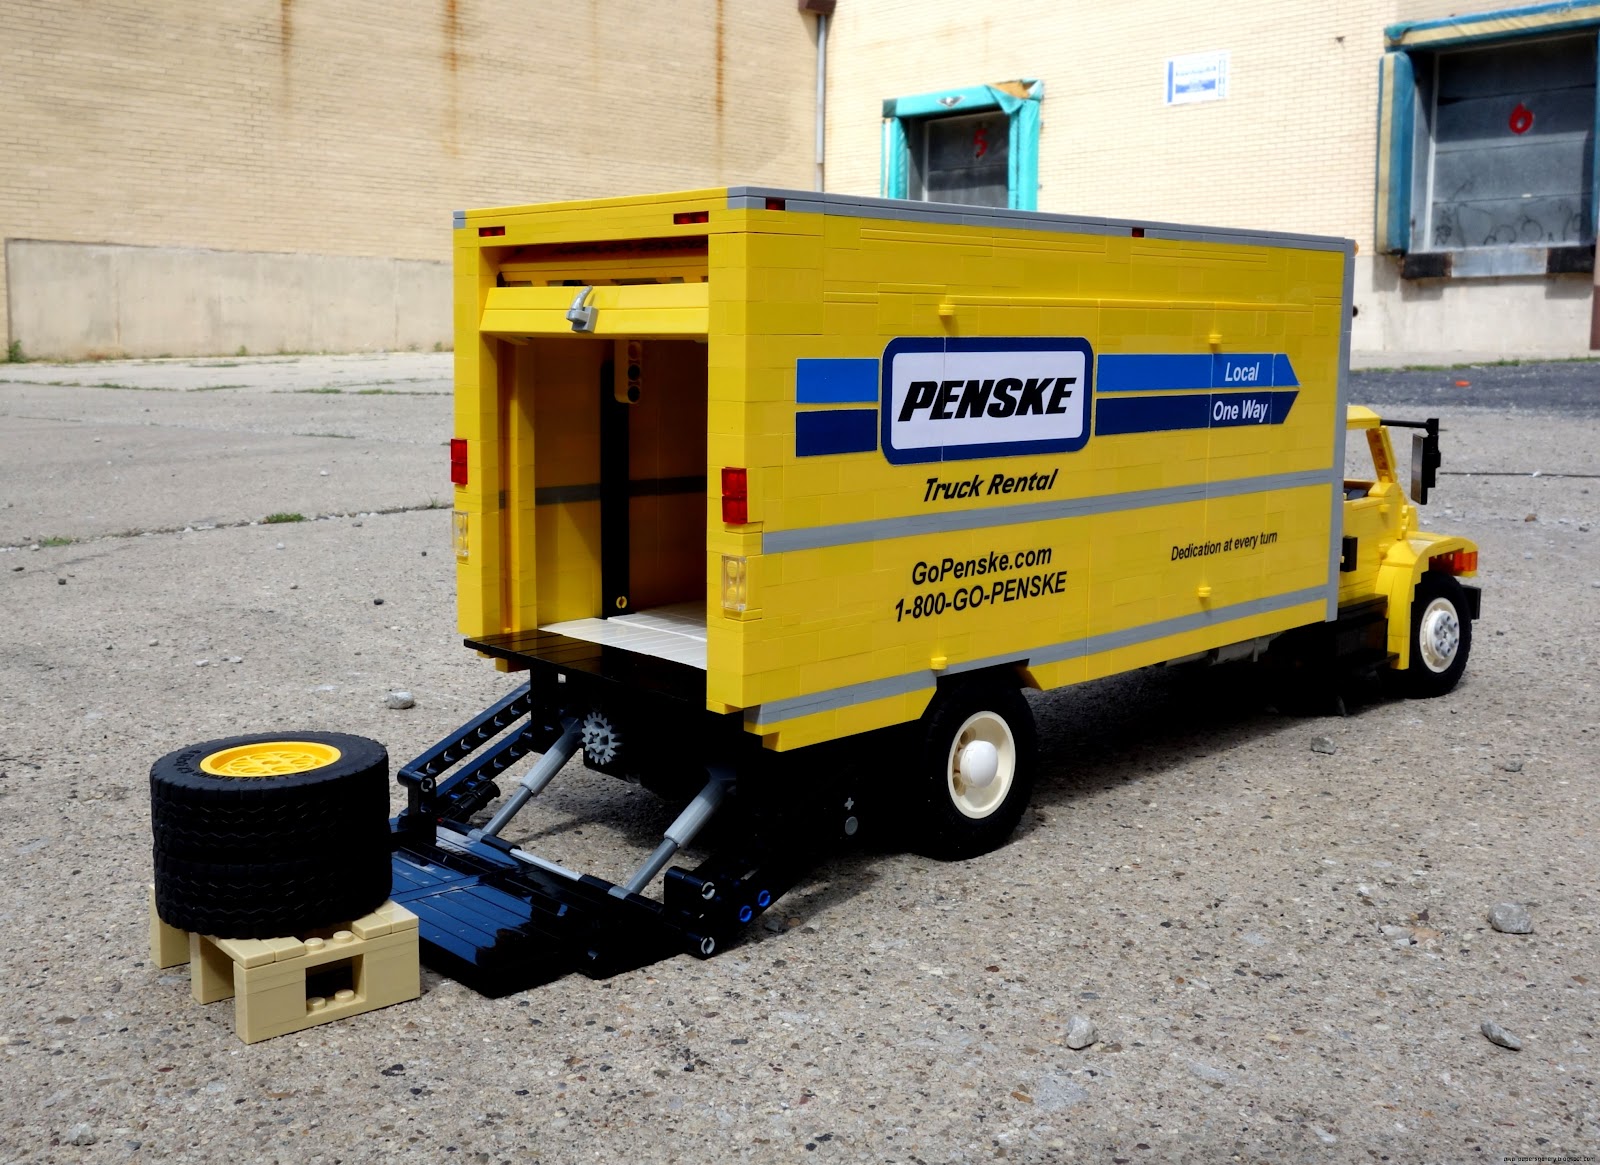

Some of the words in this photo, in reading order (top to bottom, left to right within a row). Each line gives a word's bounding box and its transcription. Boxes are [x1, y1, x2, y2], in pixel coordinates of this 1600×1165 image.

[1508, 102, 1535, 135] 6
[973, 128, 988, 159] 5
[1225, 362, 1260, 381] Local
[898, 377, 1077, 422] PENSKE
[1213, 401, 1239, 421] One
[1242, 400, 1268, 423] Way
[923, 474, 985, 502] Truck
[987, 469, 1059, 496] Rental
[1171, 541, 1221, 561] Dedication
[1223, 538, 1233, 552] at
[1234, 535, 1259, 550] every
[1260, 532, 1278, 545] turn
[912, 547, 1052, 585] GoPenske.com
[895, 571, 1067, 622] 1-800-GO-PENSKE
